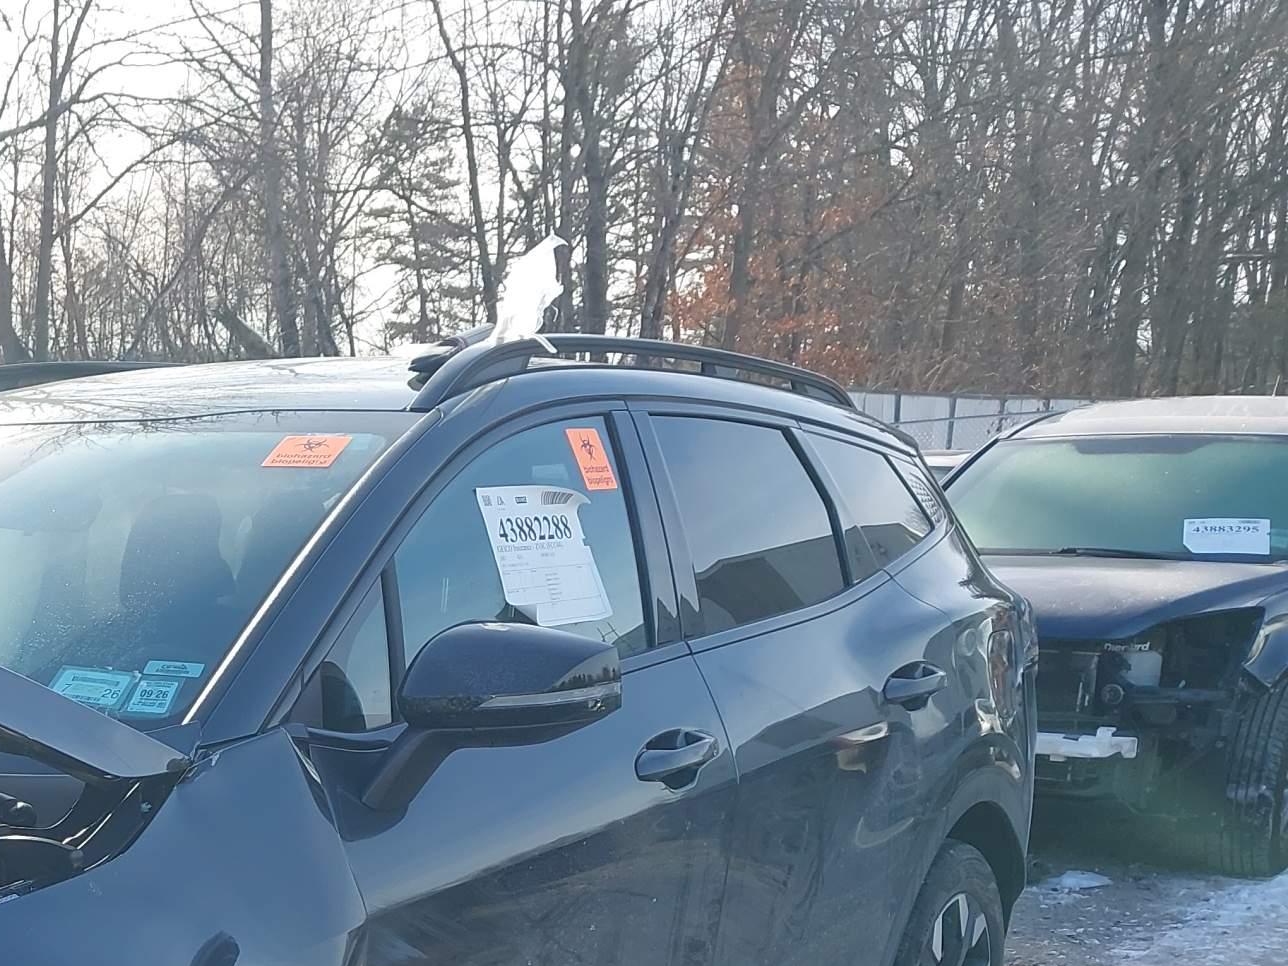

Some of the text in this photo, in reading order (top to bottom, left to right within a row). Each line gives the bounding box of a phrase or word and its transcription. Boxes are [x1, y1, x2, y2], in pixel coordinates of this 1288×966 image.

[498, 514, 572, 543] 43882288
[1192, 525, 1260, 533] 43883295
[101, 688, 121, 699] 26
